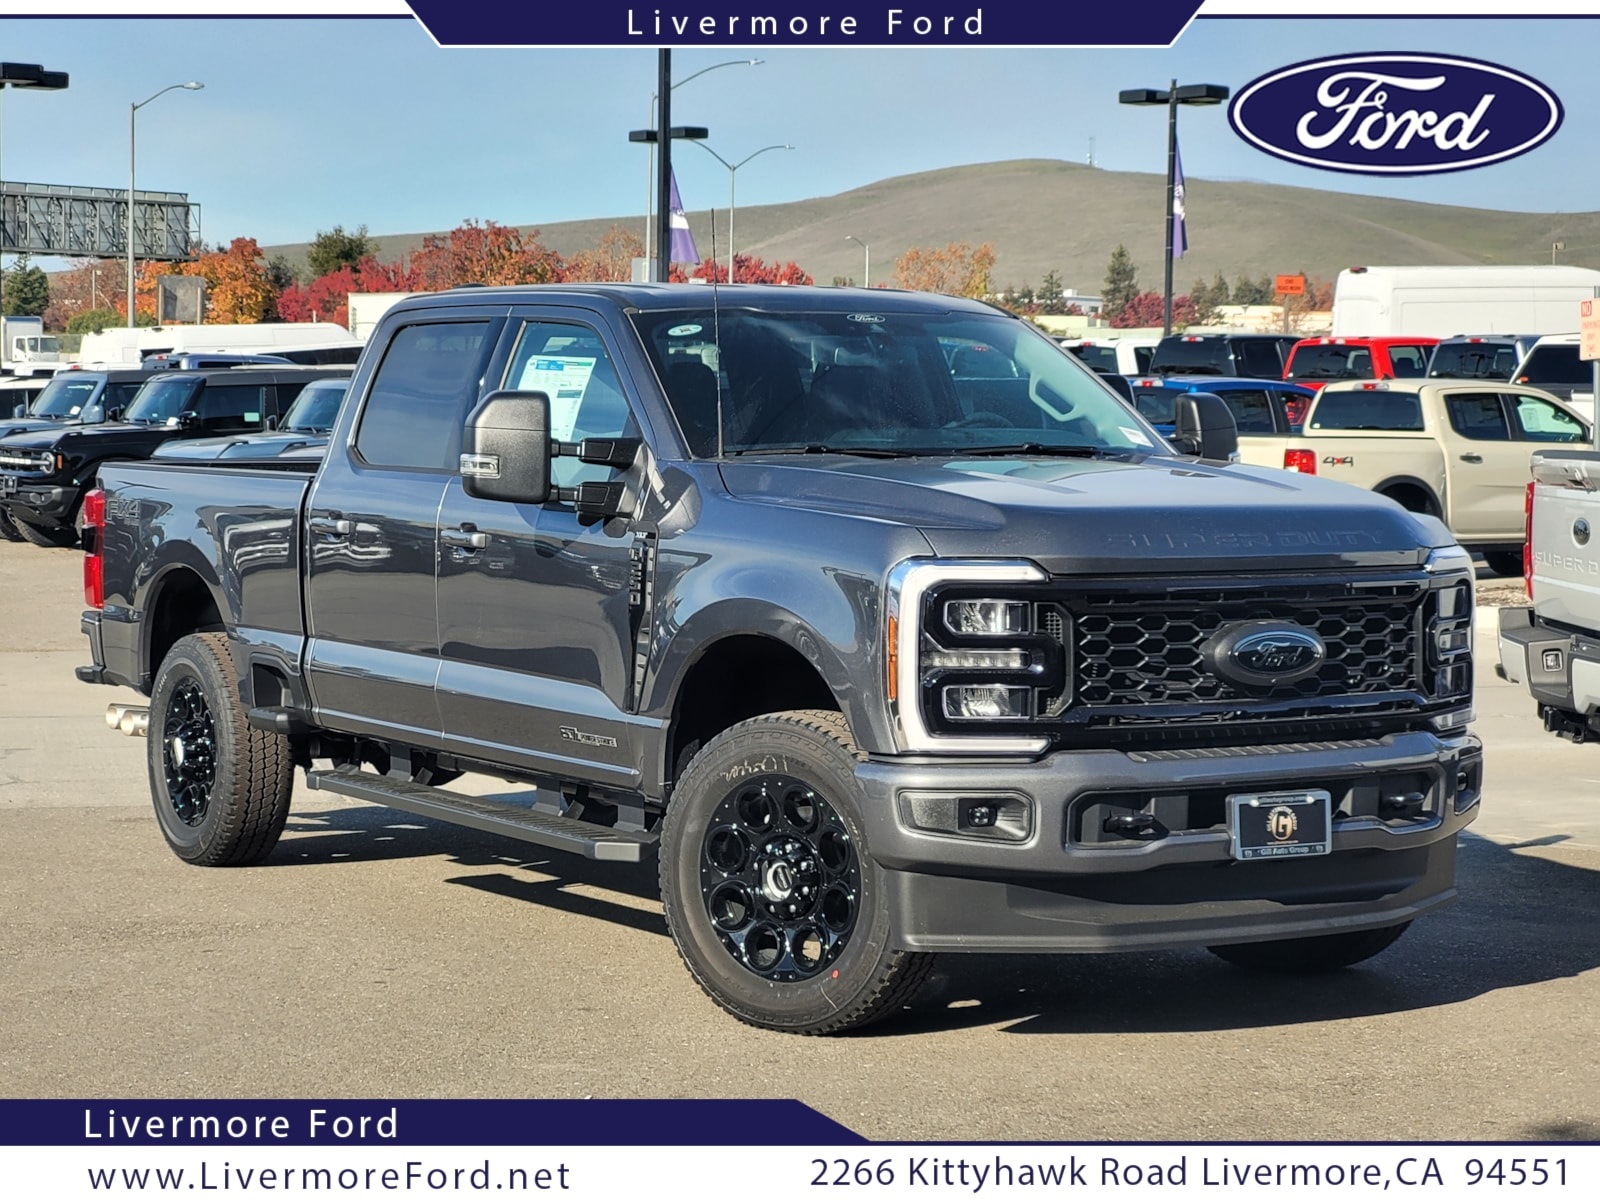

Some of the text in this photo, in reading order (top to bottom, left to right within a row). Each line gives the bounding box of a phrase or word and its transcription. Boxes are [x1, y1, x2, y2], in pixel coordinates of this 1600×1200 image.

[1581, 301, 1592, 317] NO
[1535, 551, 1585, 574] SUPER
[1252, 641, 1303, 668] Ford
